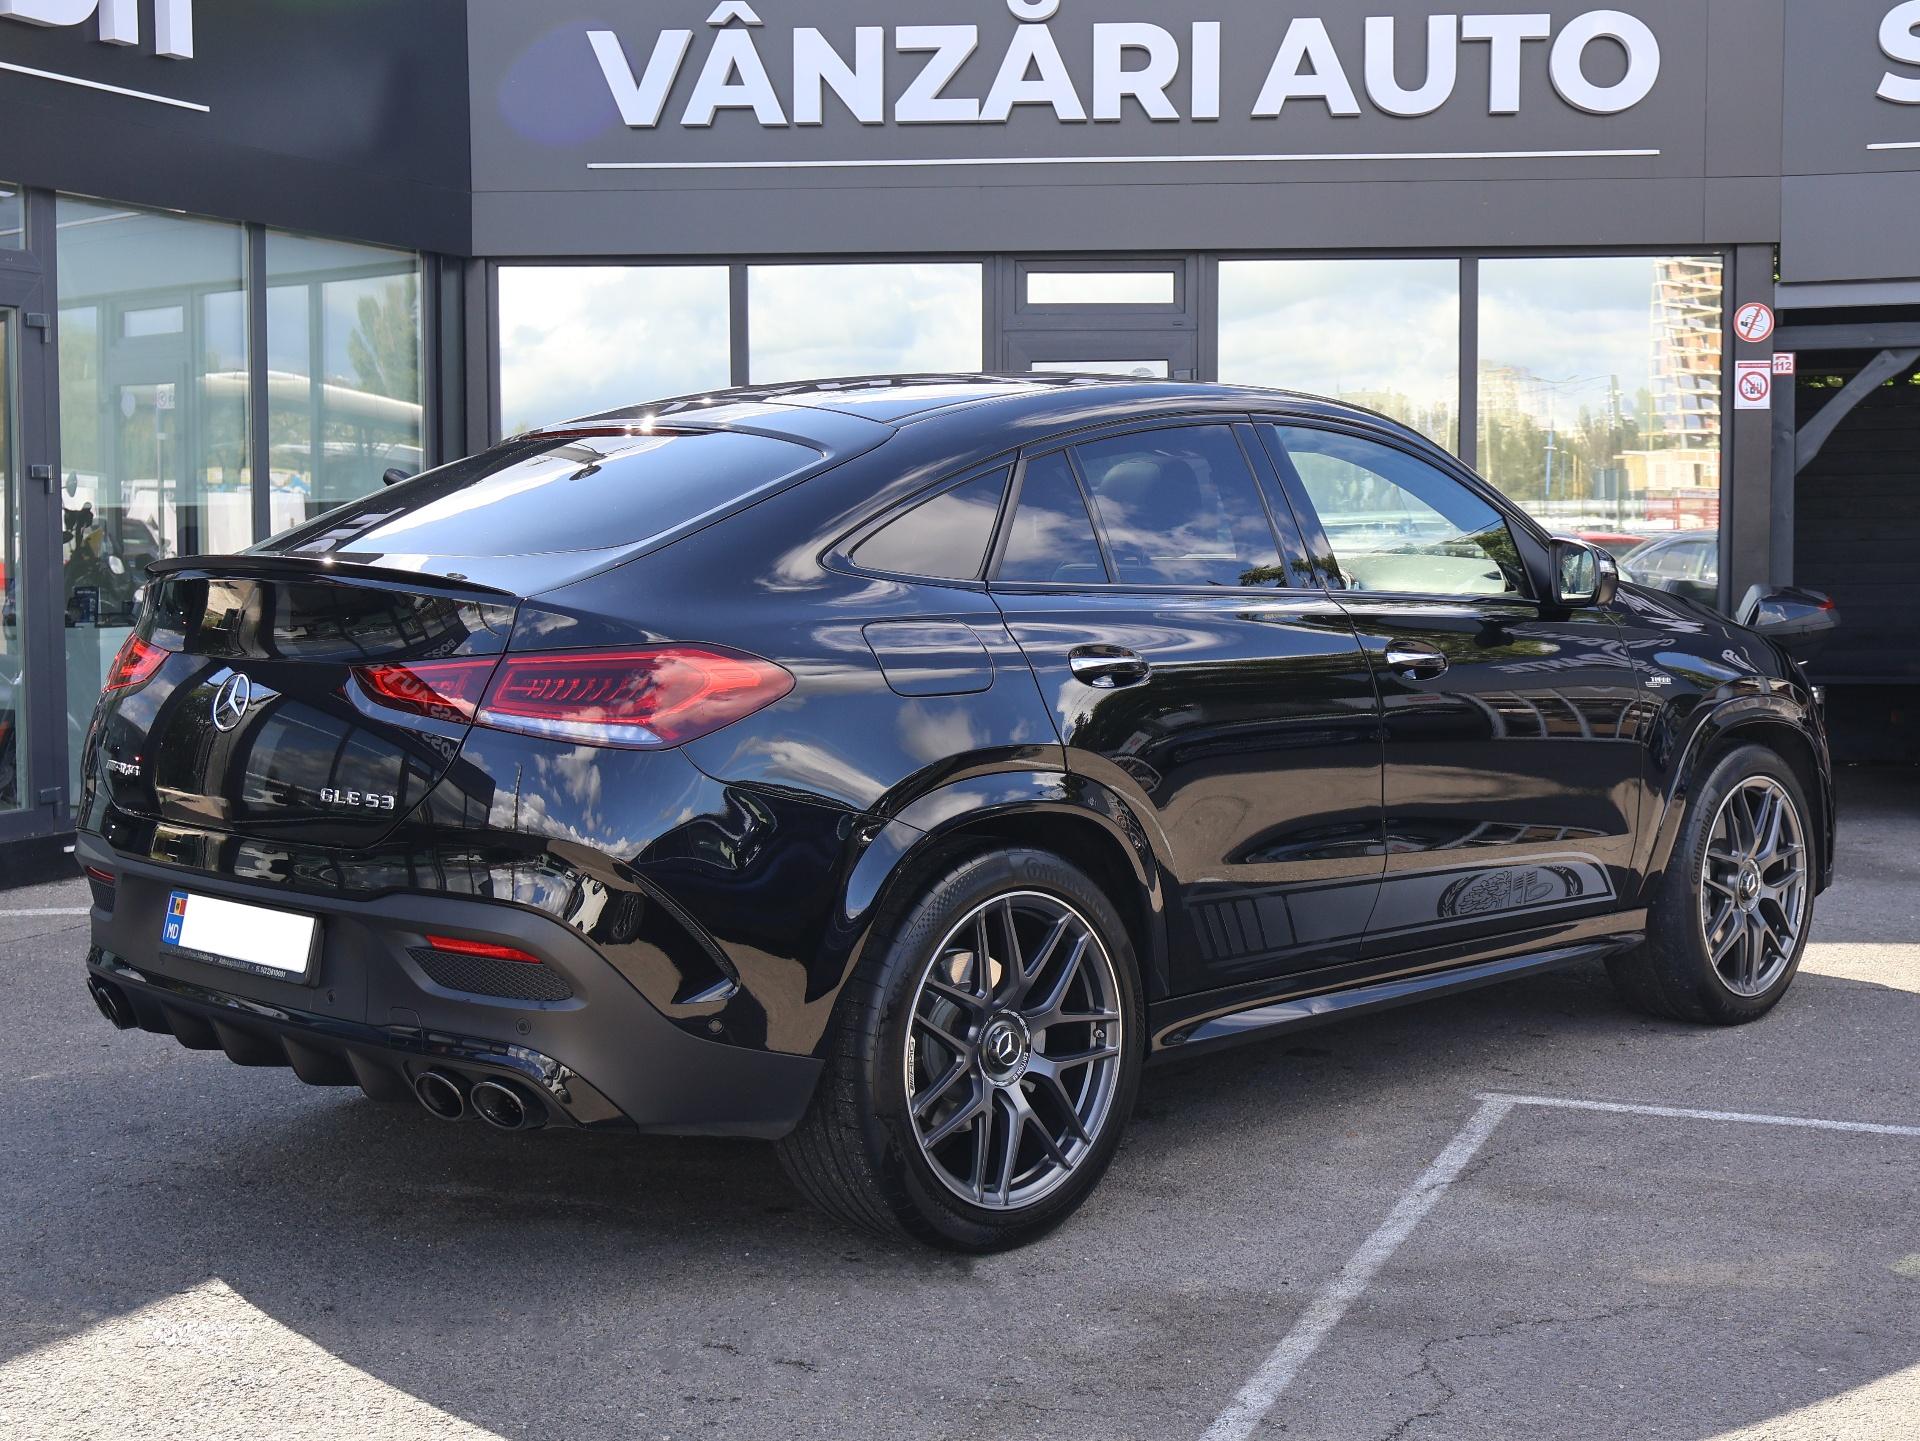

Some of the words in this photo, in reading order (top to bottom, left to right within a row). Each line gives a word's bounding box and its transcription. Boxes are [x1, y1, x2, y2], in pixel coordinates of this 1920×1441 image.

[586, 0, 1221, 127] VÂNZĂRI
[1250, 9, 1660, 117] AUTO
[1774, 361, 1792, 371] 112
[320, 788, 361, 806] GLE
[365, 793, 395, 810] 53
[166, 922, 179, 939] MD
